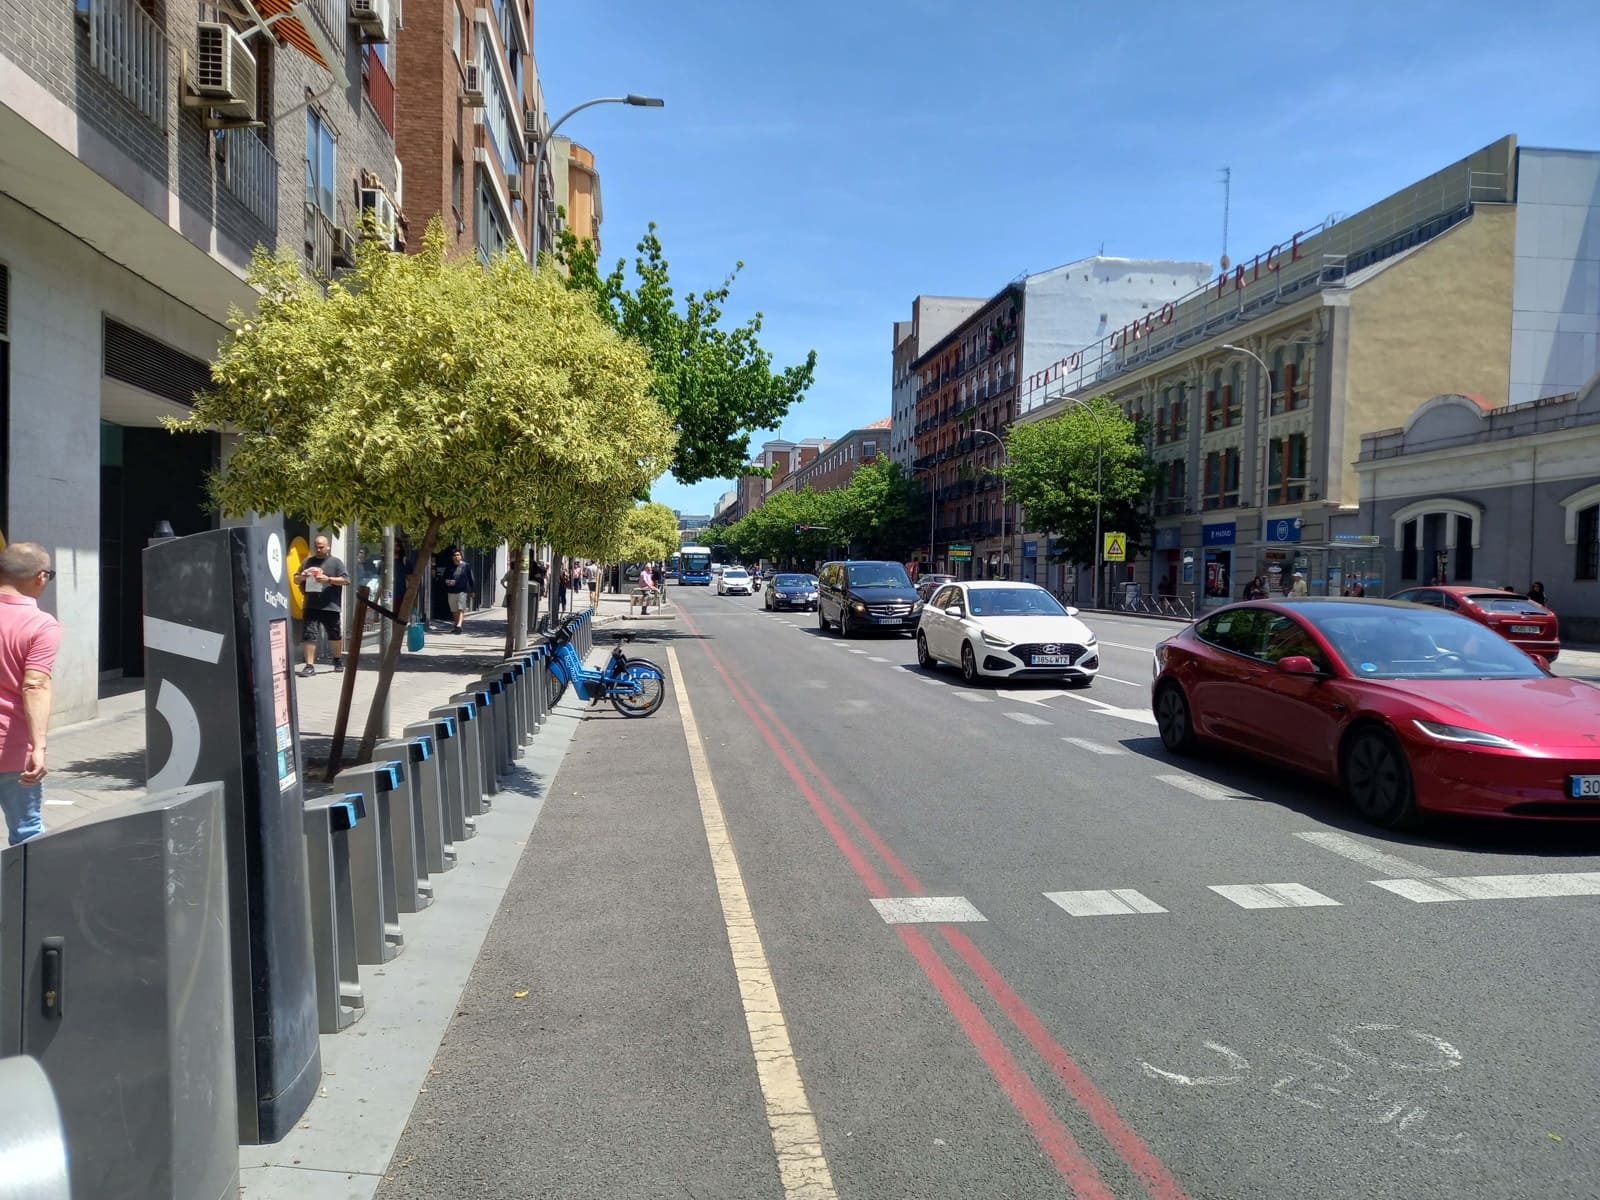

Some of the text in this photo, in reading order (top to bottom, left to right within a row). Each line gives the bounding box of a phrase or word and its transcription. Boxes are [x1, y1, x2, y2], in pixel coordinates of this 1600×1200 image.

[1029, 231, 1304, 391] TEATRO CIRCO PRICE
[1037, 656, 1054, 664] 3854
